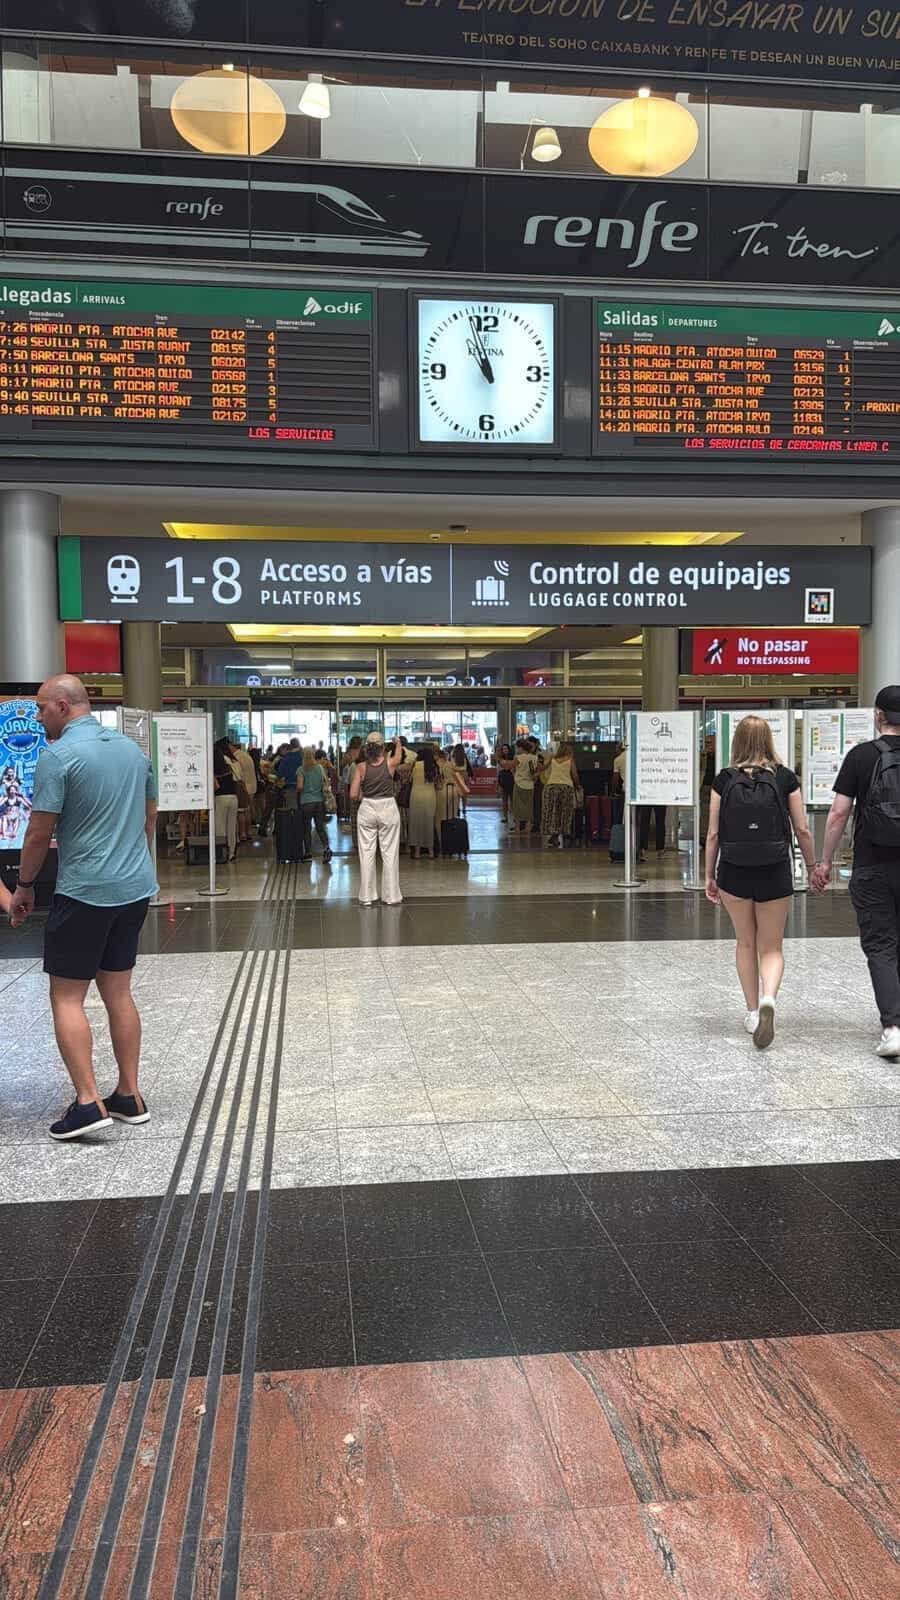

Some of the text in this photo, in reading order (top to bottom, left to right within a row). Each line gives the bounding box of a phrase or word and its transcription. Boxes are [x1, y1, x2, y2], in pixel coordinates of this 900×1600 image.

[668, 0, 803, 33] ENSAYAR
[812, 6, 853, 34] UN
[462, 31, 900, 70] TEATRO DEL SOHO CAIXABANK Y RENFE TE DESEAN UN BUEN VIAJE
[166, 196, 224, 221] renfe
[523, 200, 698, 268] renfe
[732, 221, 879, 260] Tu tren
[0, 286, 125, 306] legadas ARRIVALS
[324, 302, 363, 314] adif
[469, 315, 499, 332] 12
[604, 311, 718, 327] Salidas DEPARTURES
[30, 324, 72, 333] MADRID
[113, 327, 154, 336] ATOCHA
[157, 328, 177, 337] AVE
[211, 330, 244, 340] 02142
[31, 337, 79, 347] SEVILLA
[120, 340, 154, 350] JUSTA
[158, 341, 190, 351] AVANT
[212, 343, 245, 353] 08155
[268, 346, 275, 354] 4
[600, 344, 631, 354] 11:15
[634, 345, 670, 355] MADRID
[707, 348, 743, 357] ATOCHA
[746, 349, 776, 358] OUIGO
[845, 352, 849, 360] 1
[31, 351, 93, 361] BARCELONA
[100, 353, 134, 363] SANTS
[159, 355, 185, 365] IRYO
[212, 357, 245, 367] 06020
[268, 359, 275, 368] 5
[600, 358, 629, 367] 11:31
[634, 358, 713, 369] MALAGA-CENTRO
[719, 360, 743, 369] ALAM
[839, 365, 849, 373] 11
[31, 365, 73, 374] MADRID
[114, 367, 154, 377] ATOCHA
[158, 368, 192, 378] OUIGO
[212, 371, 245, 380] 06568
[269, 373, 273, 382] 1
[430, 363, 447, 380] 9
[526, 365, 542, 382] 3
[600, 371, 630, 380] 11:33
[633, 371, 688, 381] BARCELONA
[695, 373, 725, 382] SANTS
[747, 374, 770, 383] IRYO
[845, 377, 850, 385] 2
[32, 378, 73, 388] MADRID
[114, 381, 155, 390] ATOCHA
[158, 382, 178, 392] AVE
[212, 384, 246, 394] 02152
[269, 386, 275, 395] 3
[600, 384, 630, 393] 11:59
[633, 384, 670, 393] MADRID
[707, 386, 743, 395] ATOCHA
[746, 387, 764, 395] AVE
[32, 392, 80, 402] SEVILLA
[122, 394, 155, 404] JUSTA
[159, 396, 191, 405] AVANT
[213, 397, 246, 407] 08175
[269, 399, 275, 409] 5
[600, 397, 630, 406] 13:26
[634, 397, 676, 406] SEVILLA
[713, 399, 743, 408] JUSTA
[844, 402, 850, 410] 7
[32, 406, 73, 415] MADRID
[115, 408, 155, 417] ATOCHA
[159, 409, 179, 418] AVE
[213, 411, 246, 421] 02162
[600, 410, 630, 419] 14:00
[633, 410, 670, 419] MADRID
[706, 411, 743, 420] ATOCHA
[747, 412, 770, 421] IRYO
[479, 414, 494, 432] 6
[600, 423, 630, 432] 14:20
[633, 423, 670, 432] MADRID
[706, 424, 743, 433] ATOCHA
[249, 428, 269, 438] LOS
[685, 439, 704, 448] LOS
[708, 439, 765, 449] SERVICIOS
[770, 440, 782, 449] DE
[882, 442, 888, 451] C
[261, 558, 432, 584] Acceso a vías
[530, 562, 791, 590] Control de equipajes
[165, 557, 242, 604] 1-8
[261, 592, 362, 606] PLATFORMS
[530, 592, 687, 607] LUGGAGE CONTROL
[738, 638, 807, 656] No pasar
[738, 656, 810, 665] NO TRESPASSING
[270, 677, 305, 687] Acceso
